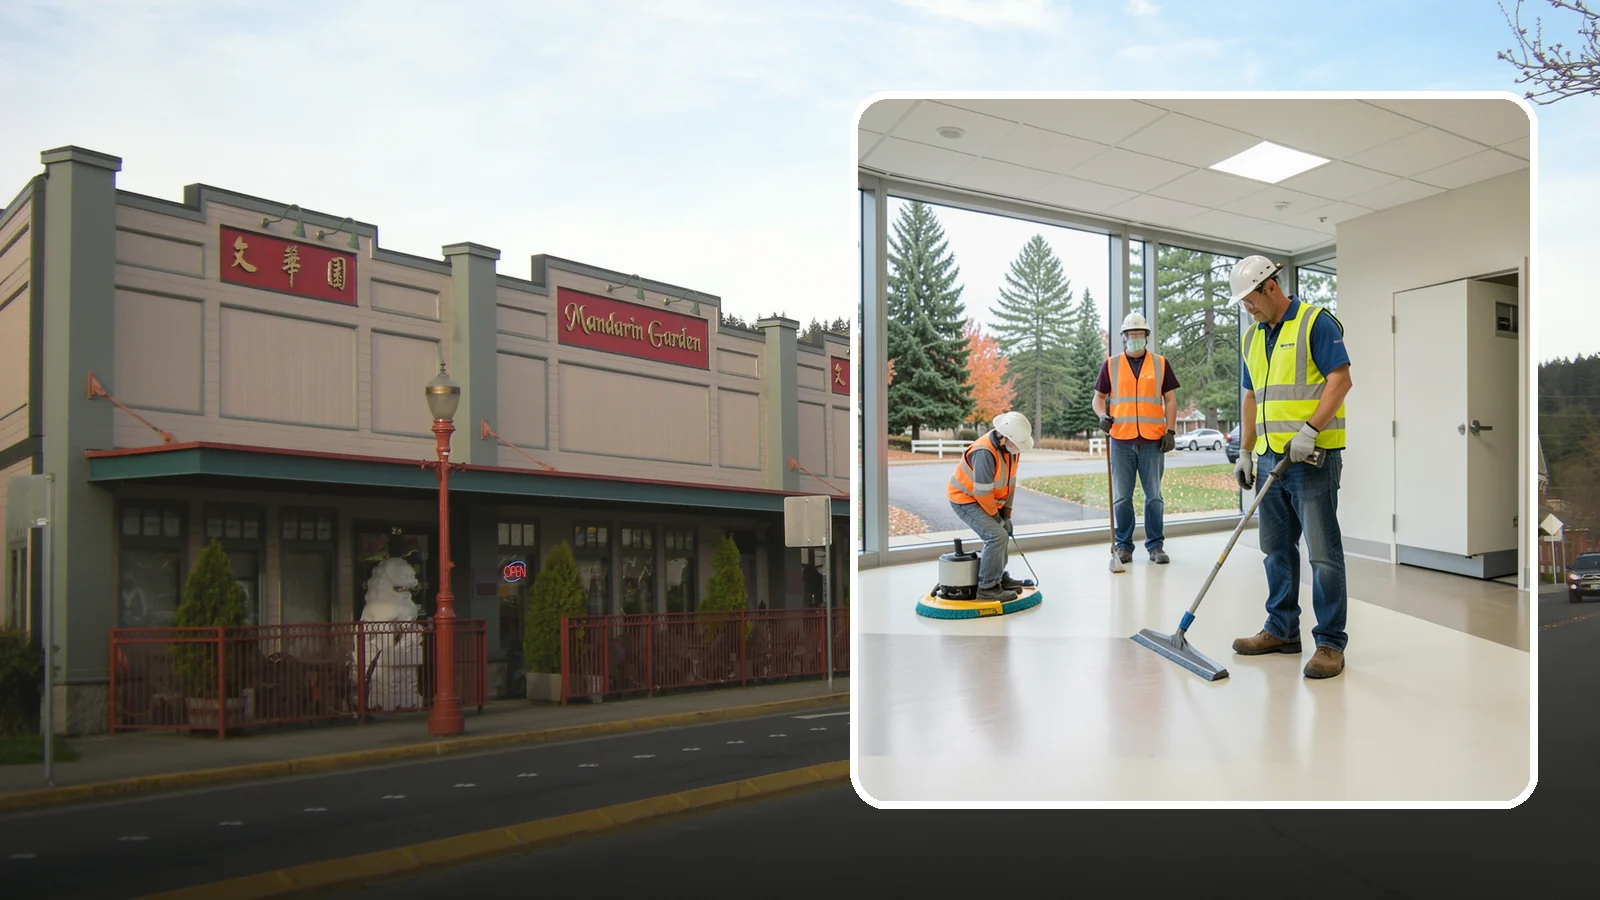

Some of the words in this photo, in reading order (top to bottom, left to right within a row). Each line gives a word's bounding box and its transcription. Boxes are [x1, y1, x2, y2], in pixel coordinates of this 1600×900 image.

[231, 235, 346, 291] 文華園
[564, 302, 643, 341] Mandarin
[648, 320, 701, 352] Garden
[503, 565, 527, 578] OPEN
